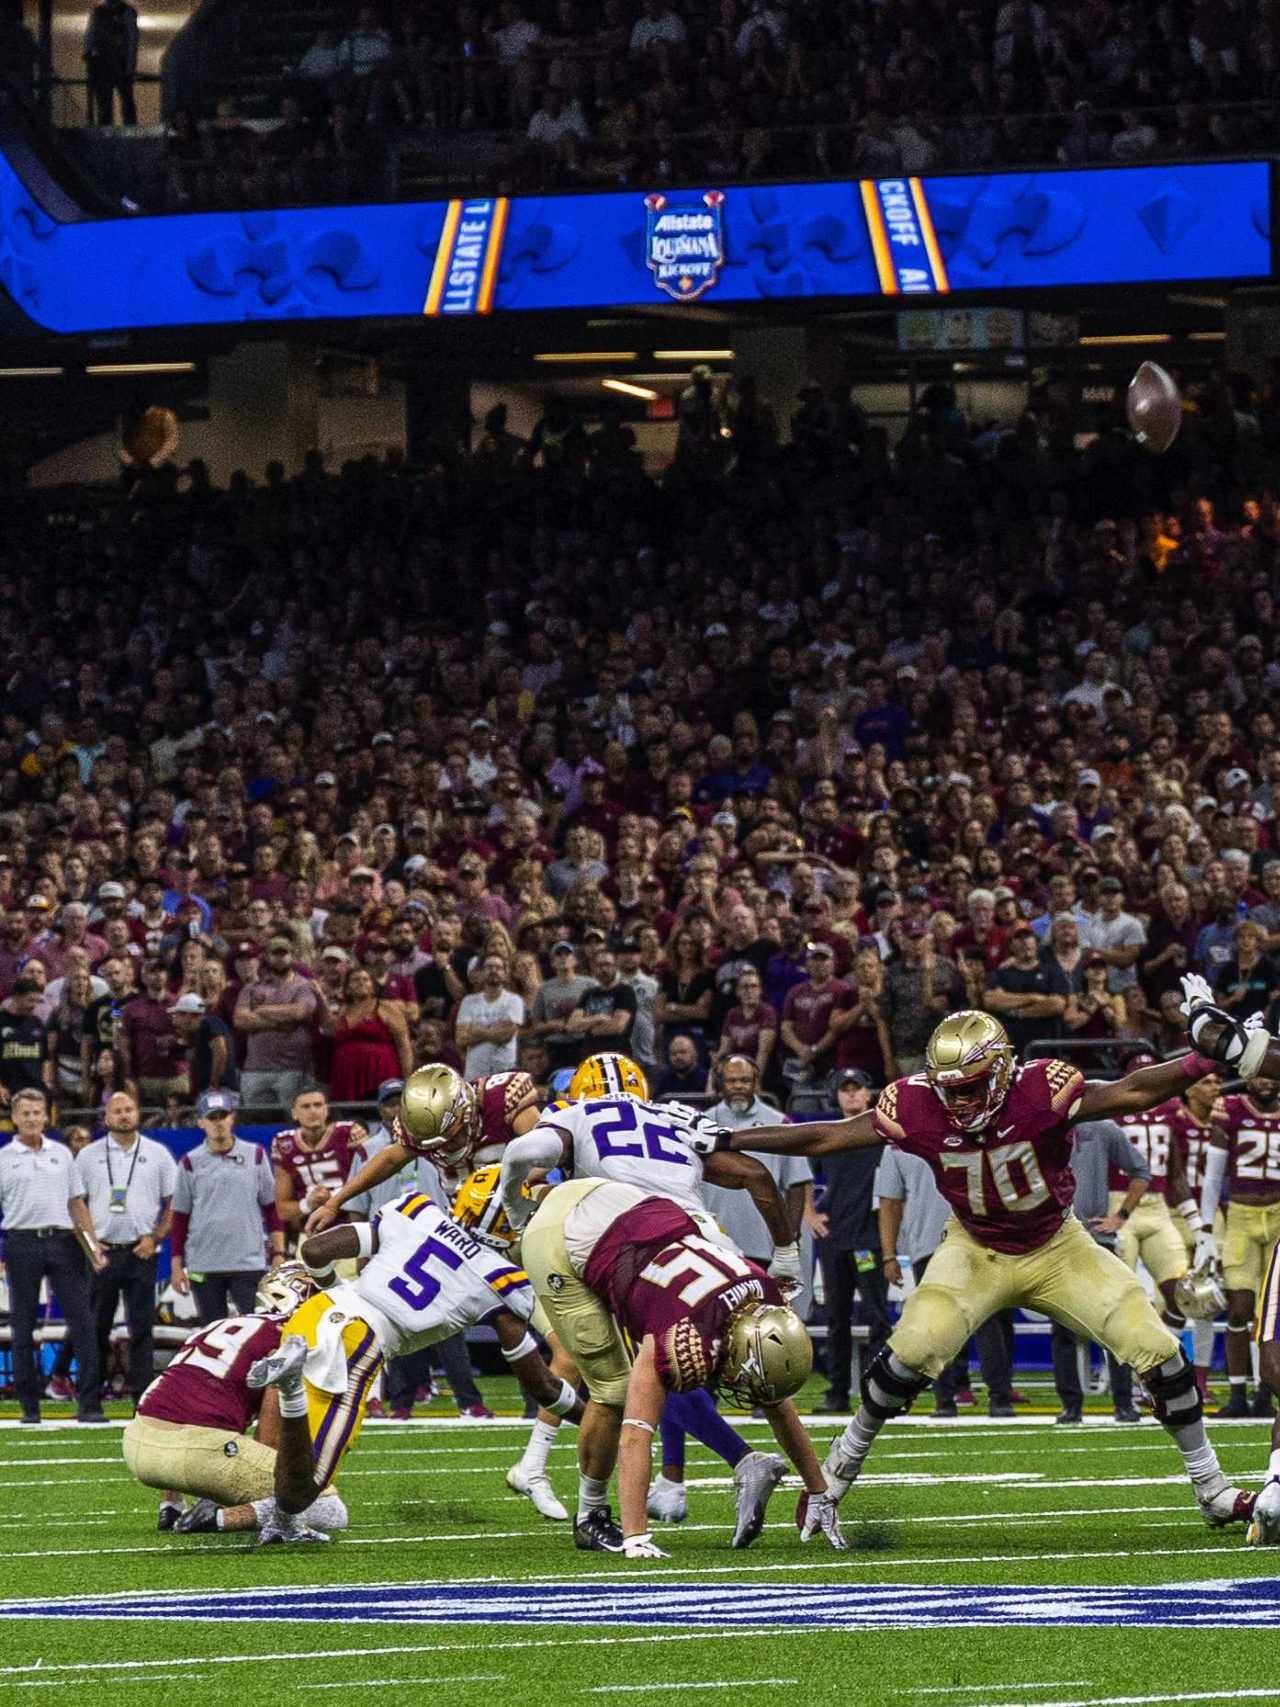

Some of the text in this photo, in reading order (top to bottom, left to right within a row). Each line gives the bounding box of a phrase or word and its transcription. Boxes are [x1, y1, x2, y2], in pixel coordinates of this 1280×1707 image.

[655, 214, 713, 232] Allstate
[585, 1100, 693, 1167] 22
[939, 1140, 1051, 1217] 70
[388, 1235, 464, 1311] 5
[433, 1219, 481, 1260] WARD
